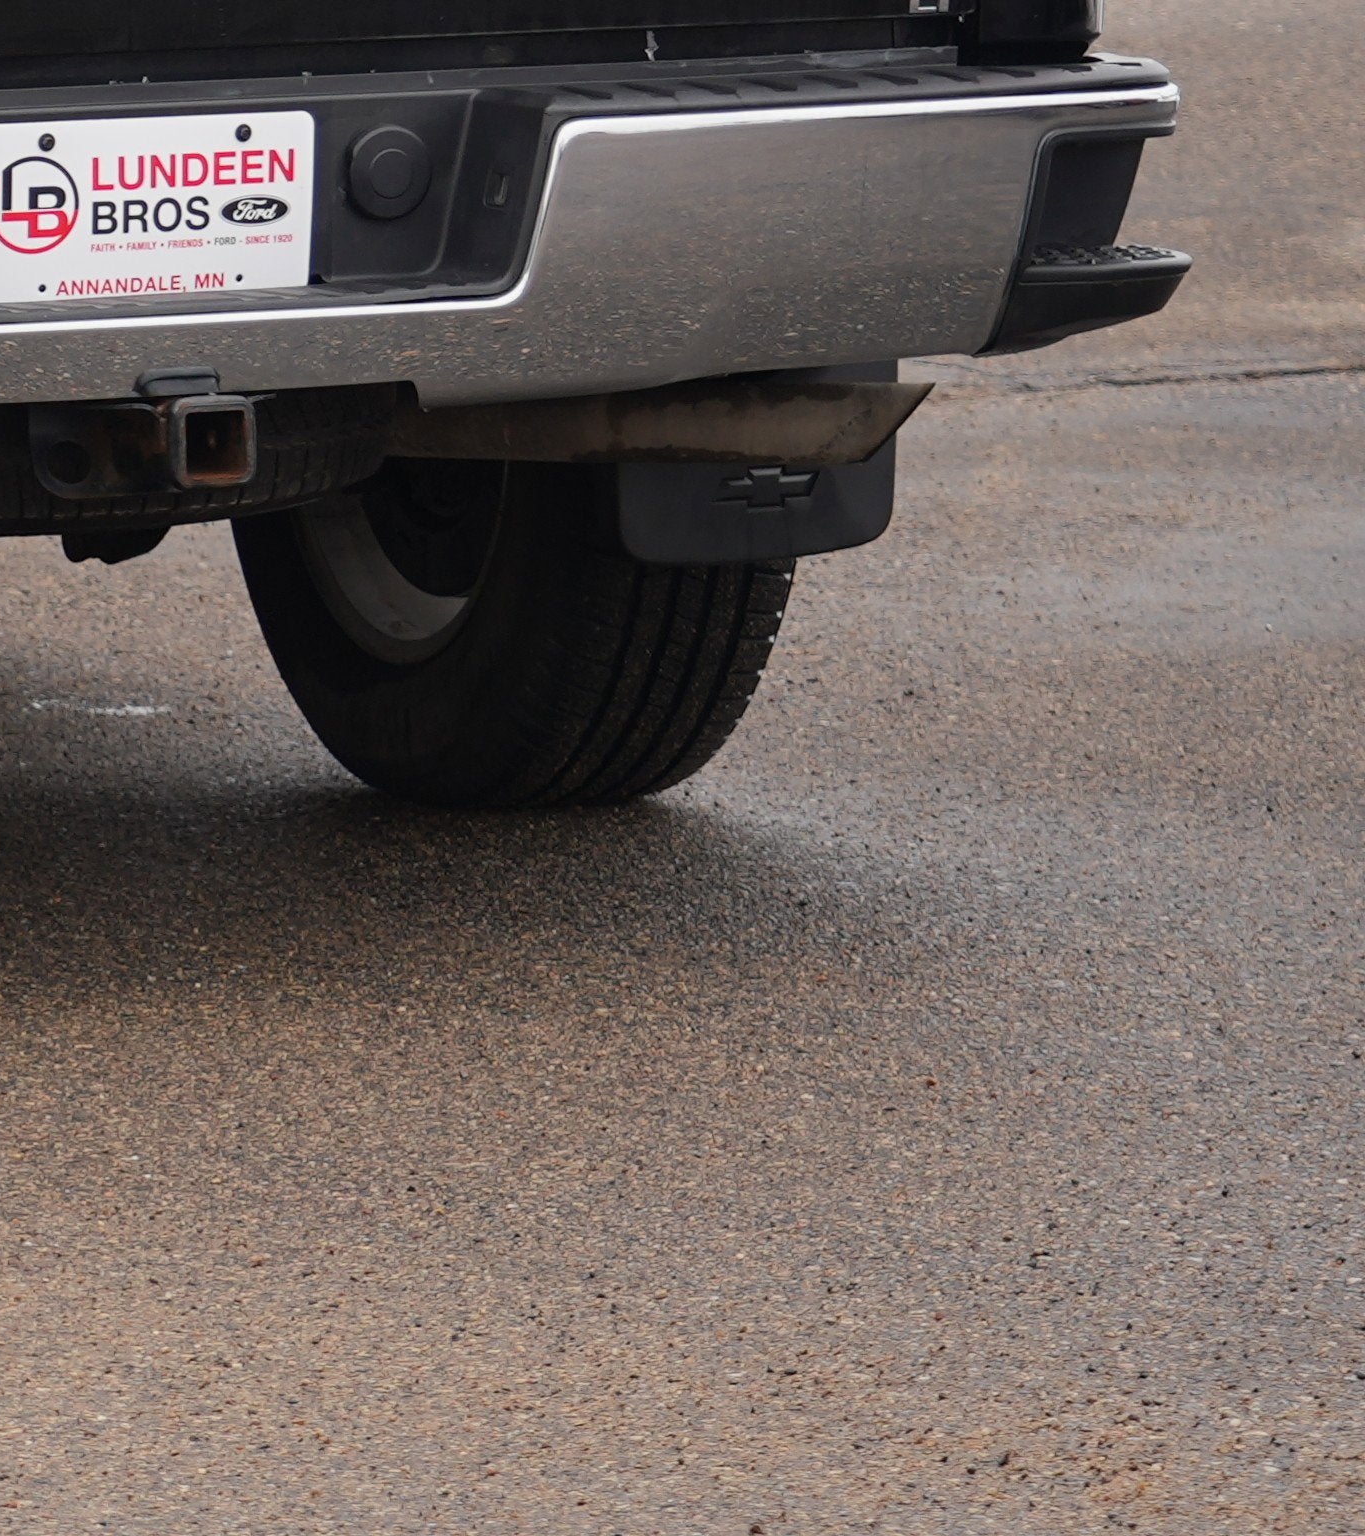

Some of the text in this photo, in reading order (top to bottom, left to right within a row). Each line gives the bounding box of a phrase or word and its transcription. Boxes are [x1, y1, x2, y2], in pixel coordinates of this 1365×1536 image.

[91, 148, 295, 191] LUNDEEN
[91, 195, 210, 235] BROS
[90, 234, 293, 252] FAITH FAMILY FRIENDS FORD SINCE 1920
[56, 272, 225, 296] ANNANDALE, MN
